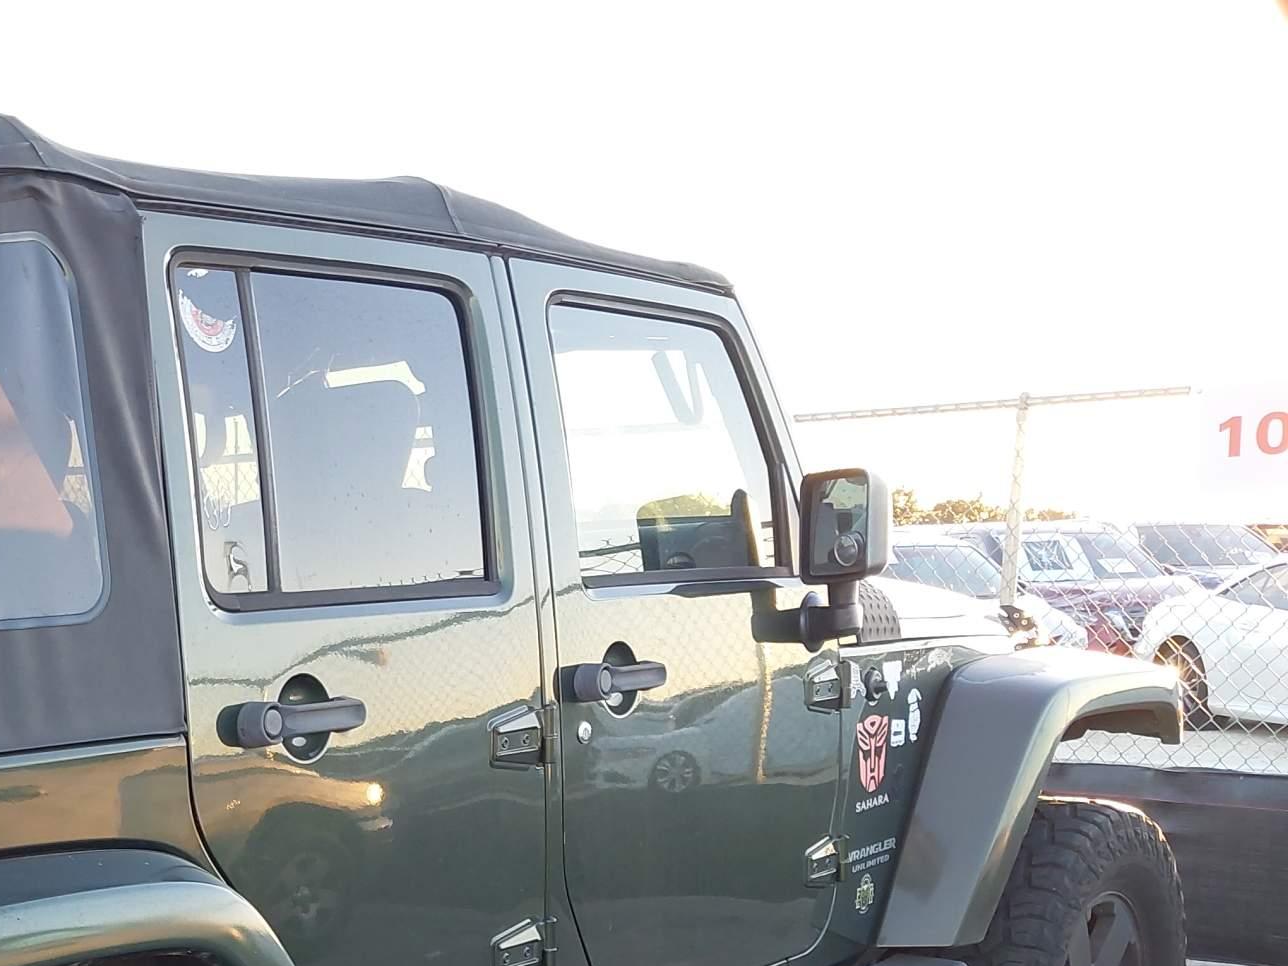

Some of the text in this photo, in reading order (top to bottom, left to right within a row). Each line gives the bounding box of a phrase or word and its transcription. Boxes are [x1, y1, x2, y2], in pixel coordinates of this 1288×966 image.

[1219, 411, 1288, 457] 10
[855, 794, 889, 813] SAHARA
[852, 855, 889, 873] UNLIMITED
